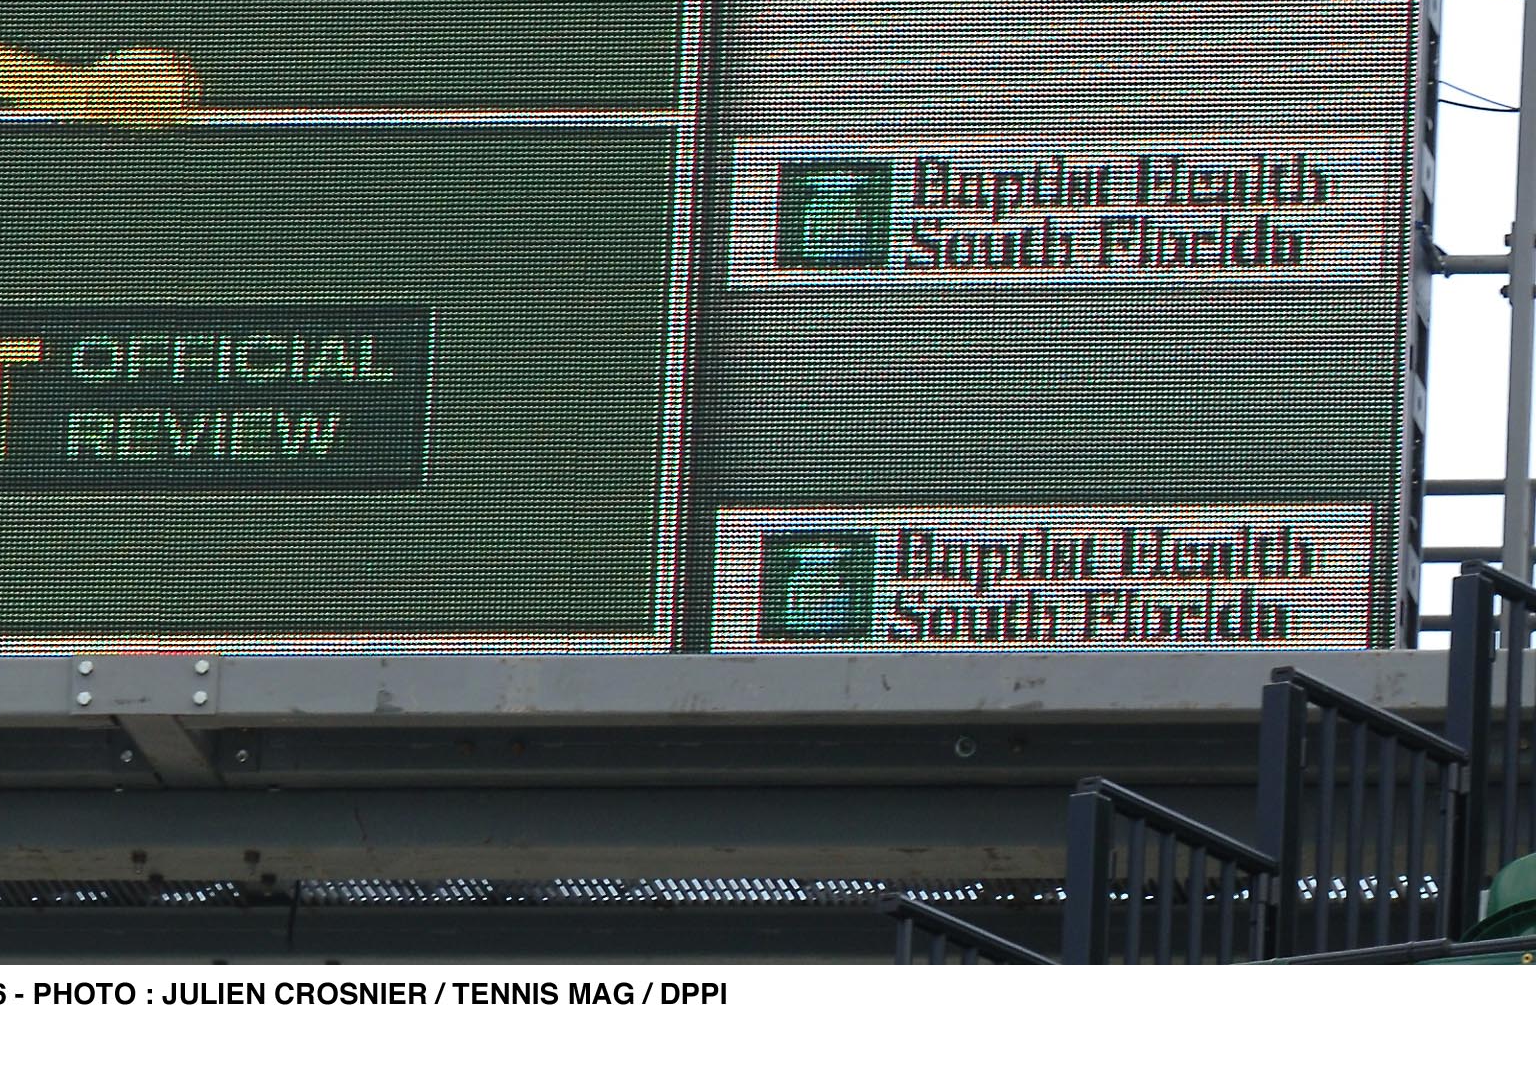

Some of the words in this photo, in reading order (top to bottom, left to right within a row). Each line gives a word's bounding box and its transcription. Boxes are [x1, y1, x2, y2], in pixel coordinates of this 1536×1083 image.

[911, 154, 1111, 220] Baptist
[1135, 153, 1328, 207] Health
[904, 218, 1073, 270] South
[1096, 215, 1303, 268] Florida
[71, 333, 396, 386] OFFICIAL
[66, 408, 343, 462] REVIEW
[895, 526, 1095, 594] Baptist
[1119, 524, 1314, 581] Health
[887, 590, 1058, 644] South
[1078, 587, 1288, 642] Florida
